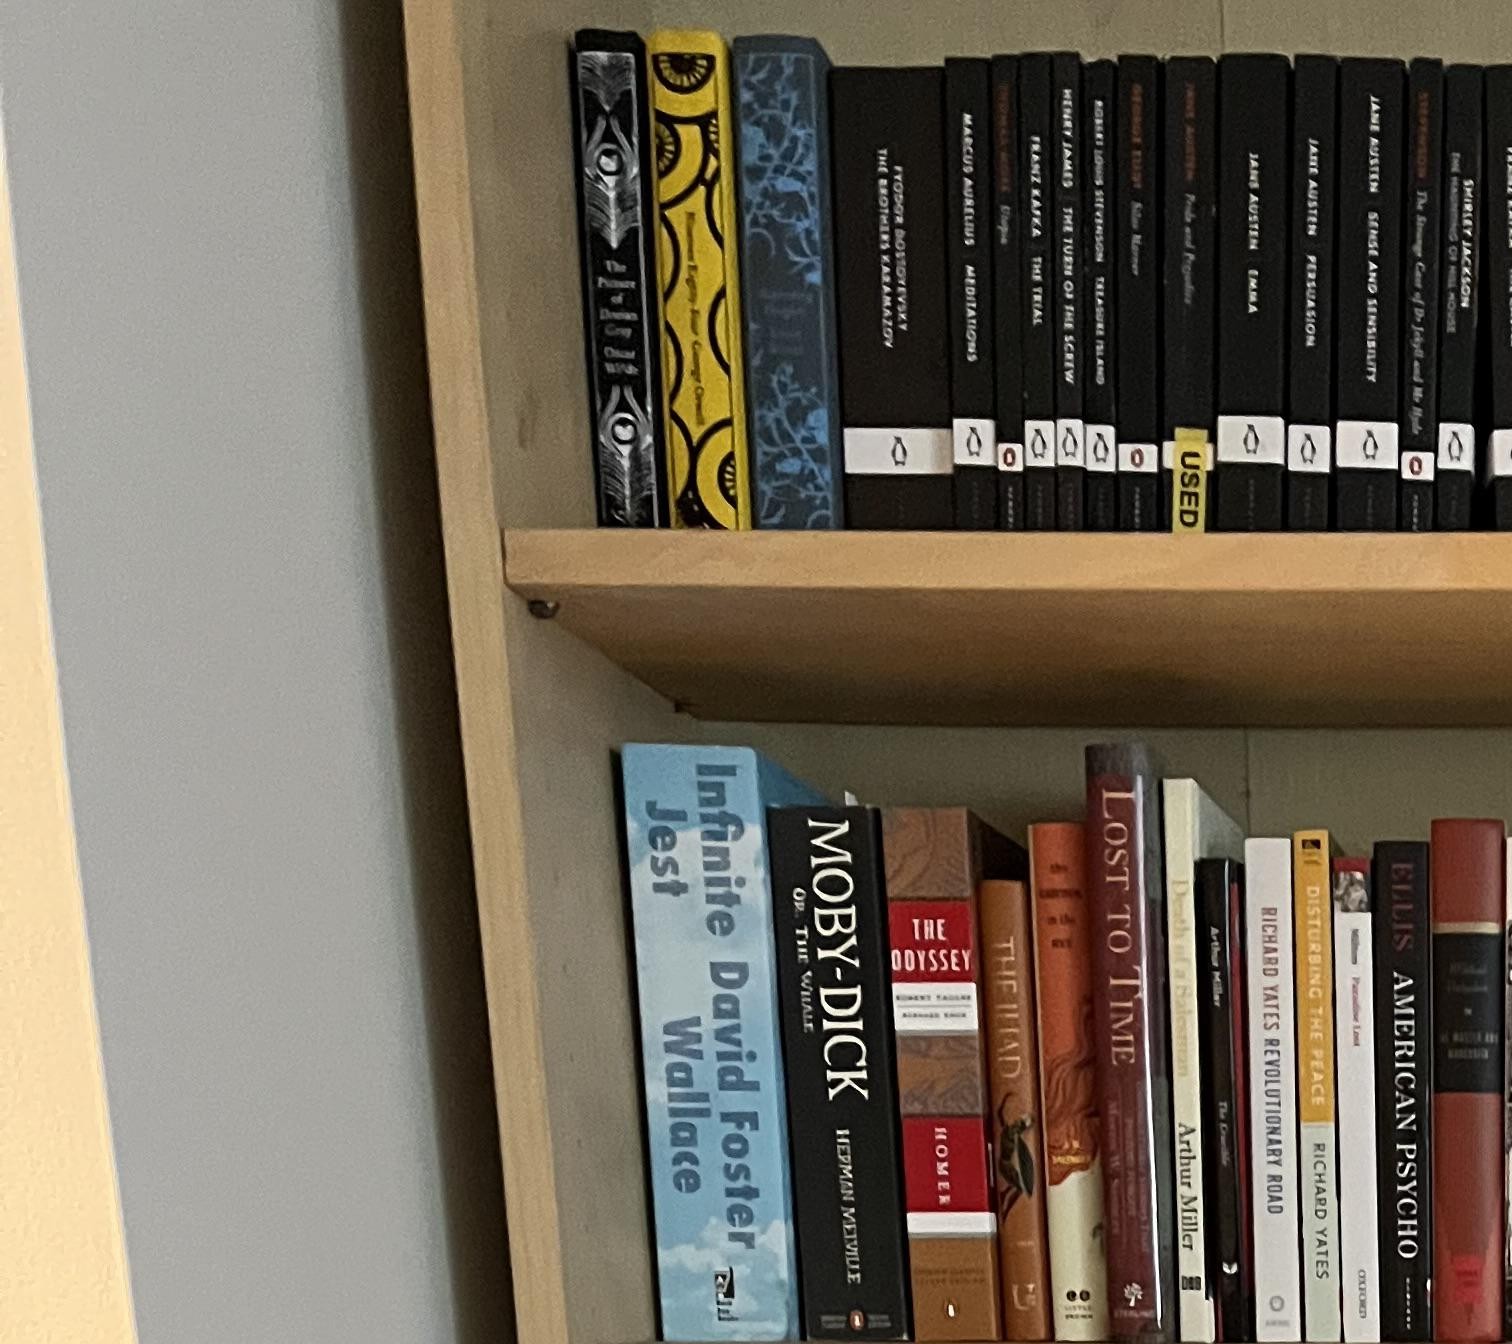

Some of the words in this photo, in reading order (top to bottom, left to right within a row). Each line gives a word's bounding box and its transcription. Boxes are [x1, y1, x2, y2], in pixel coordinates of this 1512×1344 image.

[880, 255, 894, 348] KARAMAZOV
[1179, 451, 1200, 528] USED
[646, 800, 690, 899] Jest
[696, 762, 746, 938] Infinite
[1102, 788, 1135, 890] LOST
[807, 817, 869, 1101] MOBY-DICK
[1107, 904, 1134, 954] TO
[1261, 907, 1282, 978] RICHARD
[709, 960, 760, 1094] David
[1107, 965, 1143, 1066] TIME
[1263, 982, 1283, 1031] YATES
[1392, 971, 1417, 1132] AMERICAN
[661, 1016, 712, 1194] Wallace
[1264, 1038, 1284, 1168] REVOLUTIONARY
[720, 1109, 760, 1250] Foster
[1178, 1122, 1199, 1189] Arthur
[1266, 1173, 1285, 1214] ROAD
[1395, 1142, 1419, 1260] PSYCHO
[1180, 1194, 1200, 1250] Miller
